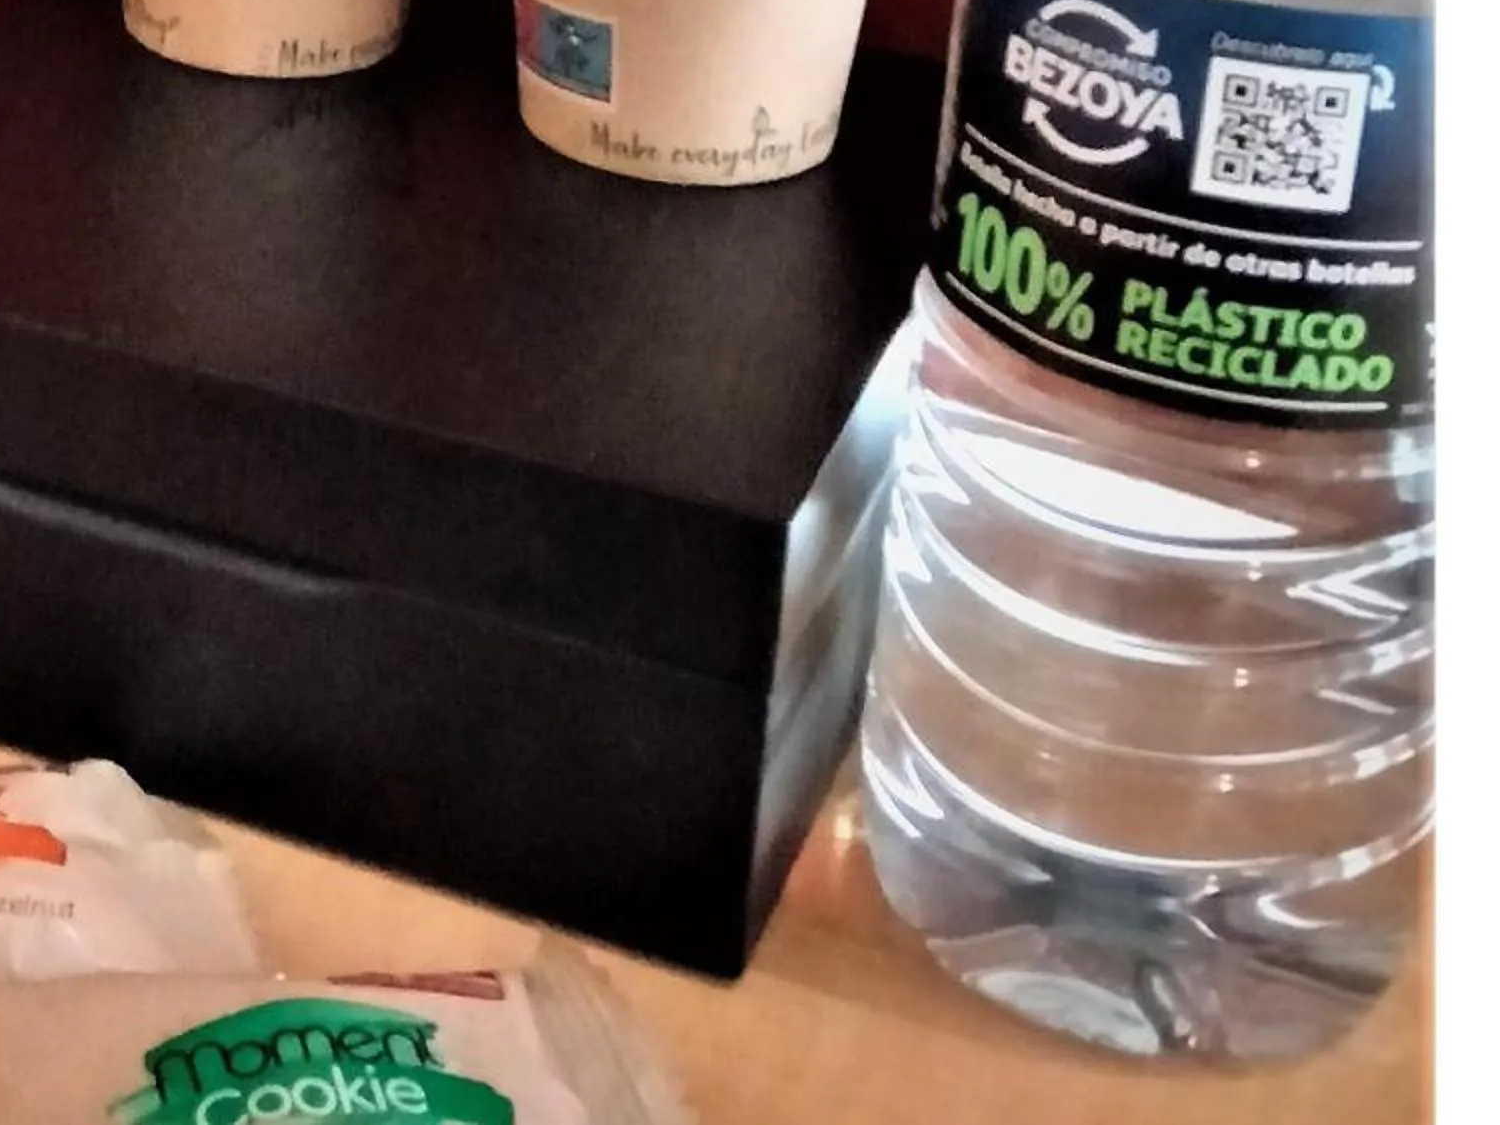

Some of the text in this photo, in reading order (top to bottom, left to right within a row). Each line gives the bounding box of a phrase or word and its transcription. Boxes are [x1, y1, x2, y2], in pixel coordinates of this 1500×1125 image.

[1004, 33, 1184, 140] BEZOYA
[590, 121, 658, 159] Make
[671, 125, 794, 177] everyday
[957, 192, 1095, 341] 100%
[1012, 178, 1077, 228] hecha
[1100, 219, 1180, 260] partir
[1183, 242, 1221, 268] de
[1224, 252, 1302, 284] otras
[1305, 257, 1416, 286] botellas
[1122, 278, 1367, 352] PLÁSTICO
[1116, 319, 1395, 393] RECICLADO
[194, 1066, 429, 1125] Cookie
